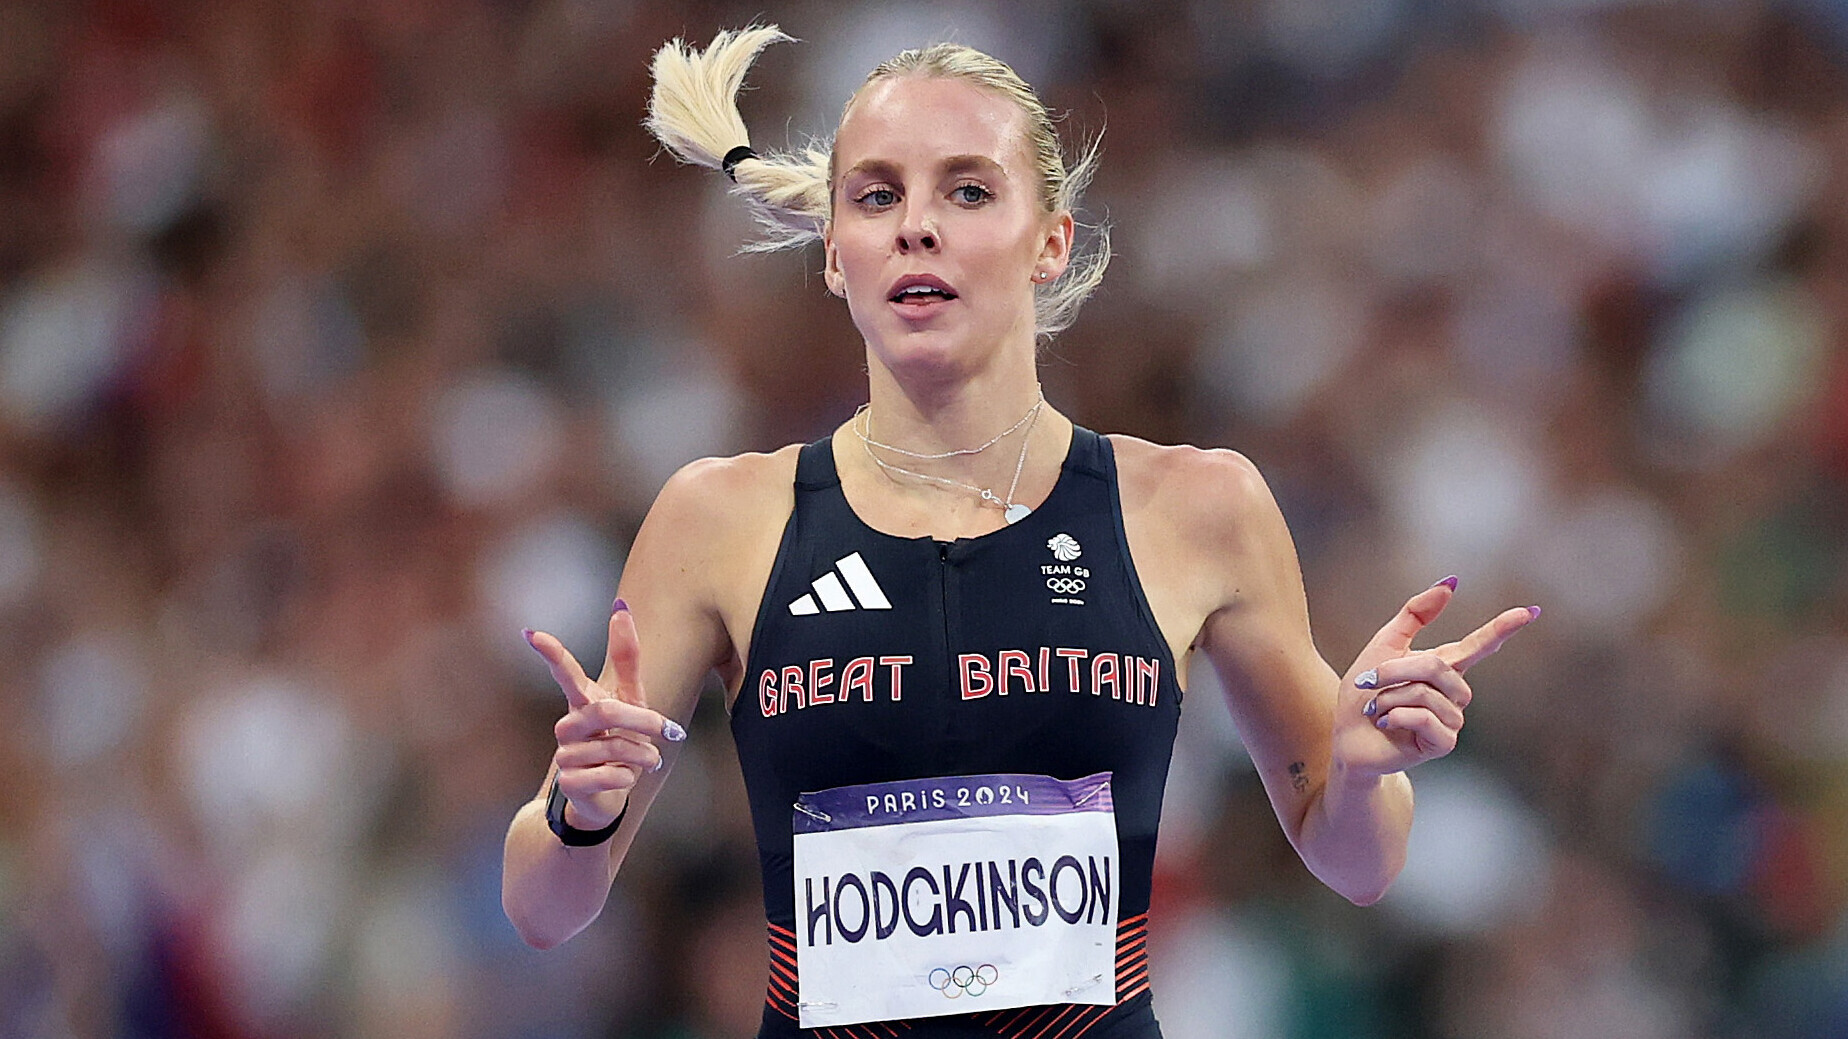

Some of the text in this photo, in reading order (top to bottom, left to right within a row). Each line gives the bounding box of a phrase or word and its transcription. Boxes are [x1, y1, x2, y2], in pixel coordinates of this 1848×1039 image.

[1040, 565, 1090, 578] TEAM GB
[758, 646, 1160, 718] GREAT BRITAIN
[957, 785, 1029, 807] 2024
[805, 854, 1110, 947] HODGKINSON
